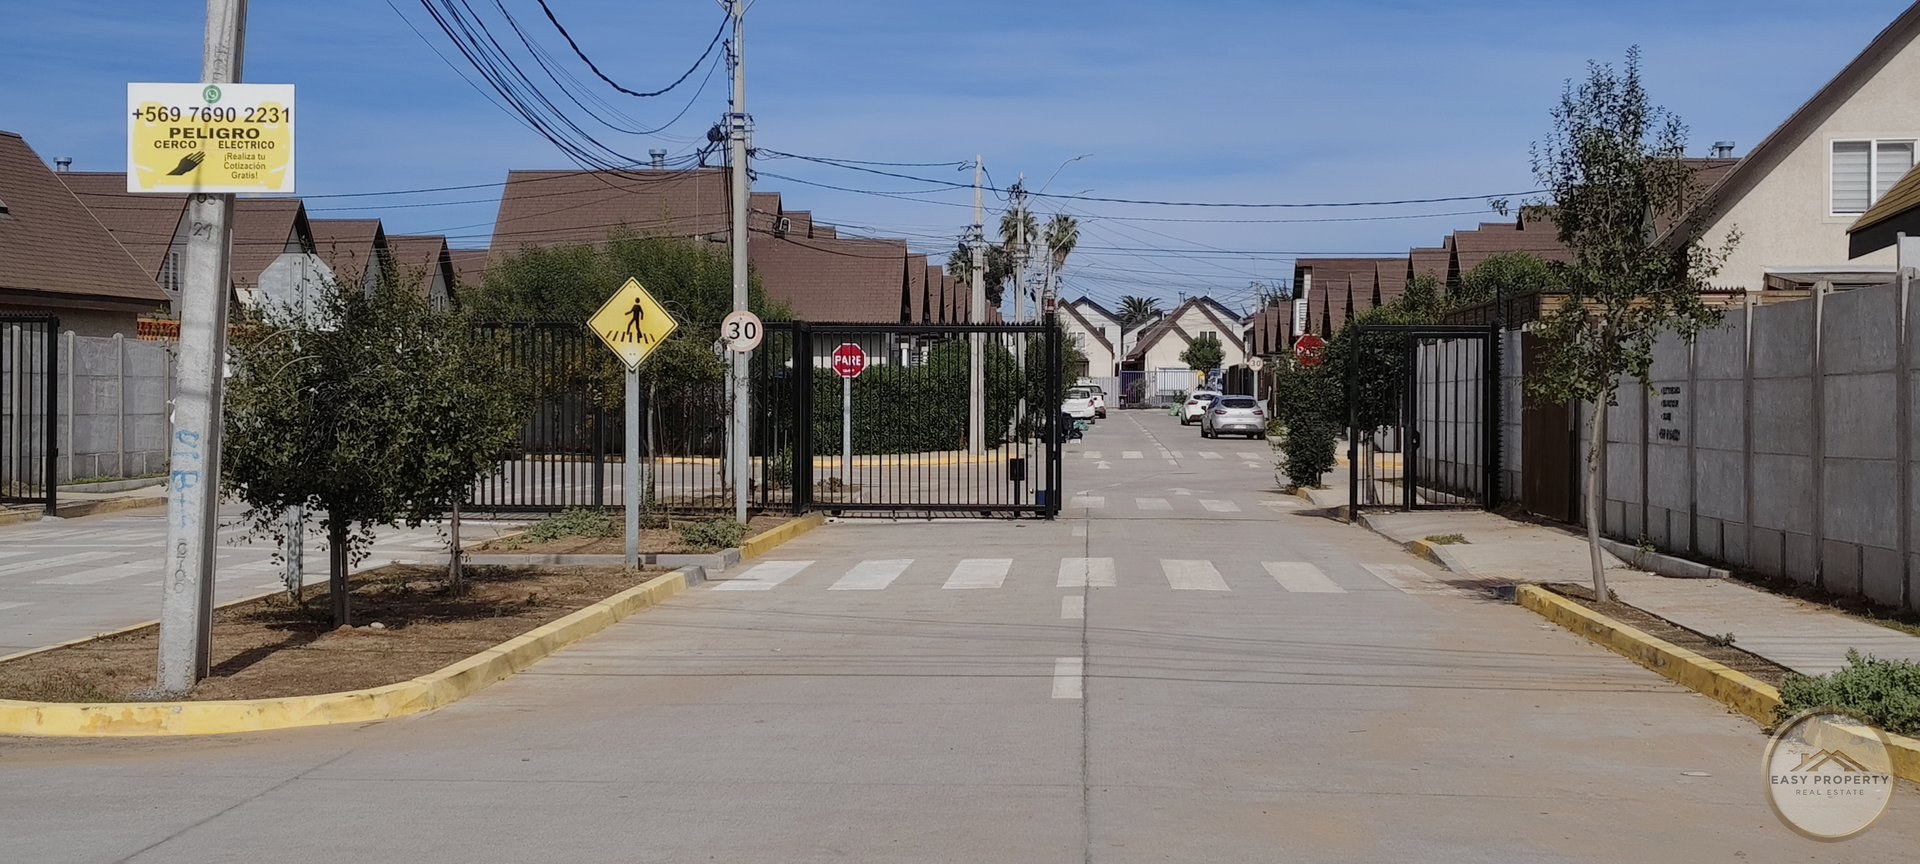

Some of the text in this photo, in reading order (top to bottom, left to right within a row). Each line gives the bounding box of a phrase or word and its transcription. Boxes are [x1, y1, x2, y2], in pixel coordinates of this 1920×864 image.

[132, 106, 290, 124] +569 7690 2231
[169, 127, 260, 139] PELIGRO
[154, 140, 275, 149] CERCO ELECTRICO
[224, 152, 266, 161] ¡Realiza tu
[223, 161, 266, 170] Cotización
[231, 171, 258, 179] Gratis!
[729, 322, 757, 339] 30
[835, 355, 862, 366] PARE
